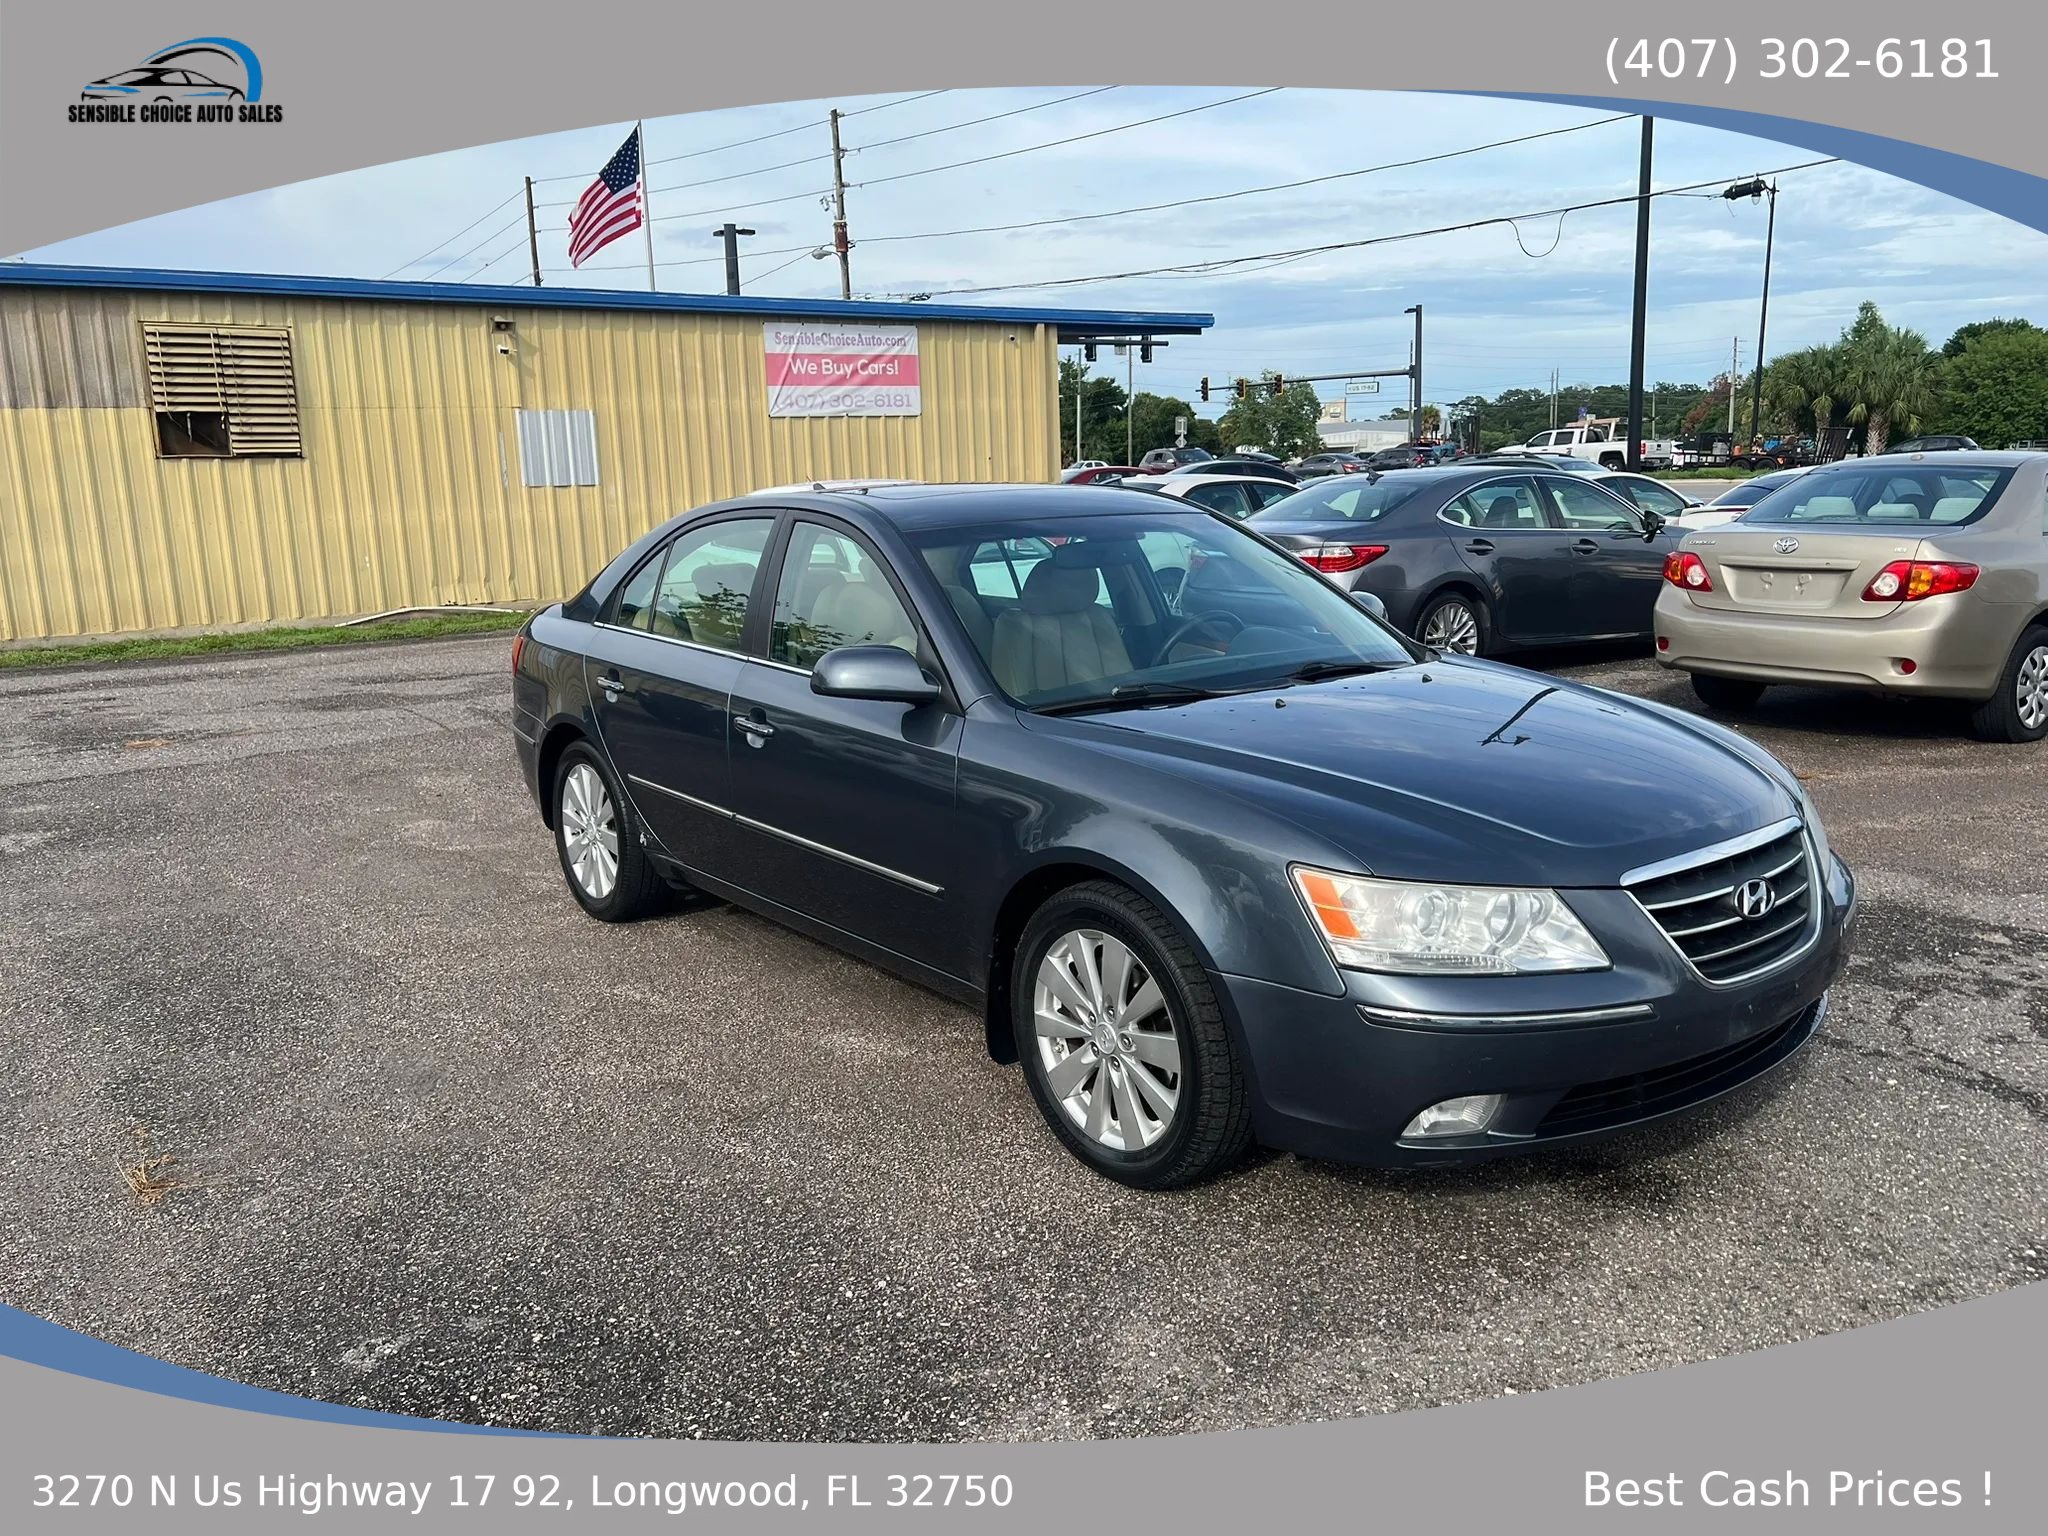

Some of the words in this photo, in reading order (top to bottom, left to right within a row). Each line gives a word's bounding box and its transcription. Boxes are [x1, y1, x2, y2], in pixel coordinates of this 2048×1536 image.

[774, 331, 907, 347] SensibleChoiceAuto.com
[791, 359, 818, 375] We
[821, 358, 855, 379] Buy
[857, 359, 900, 376] Cars!
[829, 393, 913, 409] 302-6181
